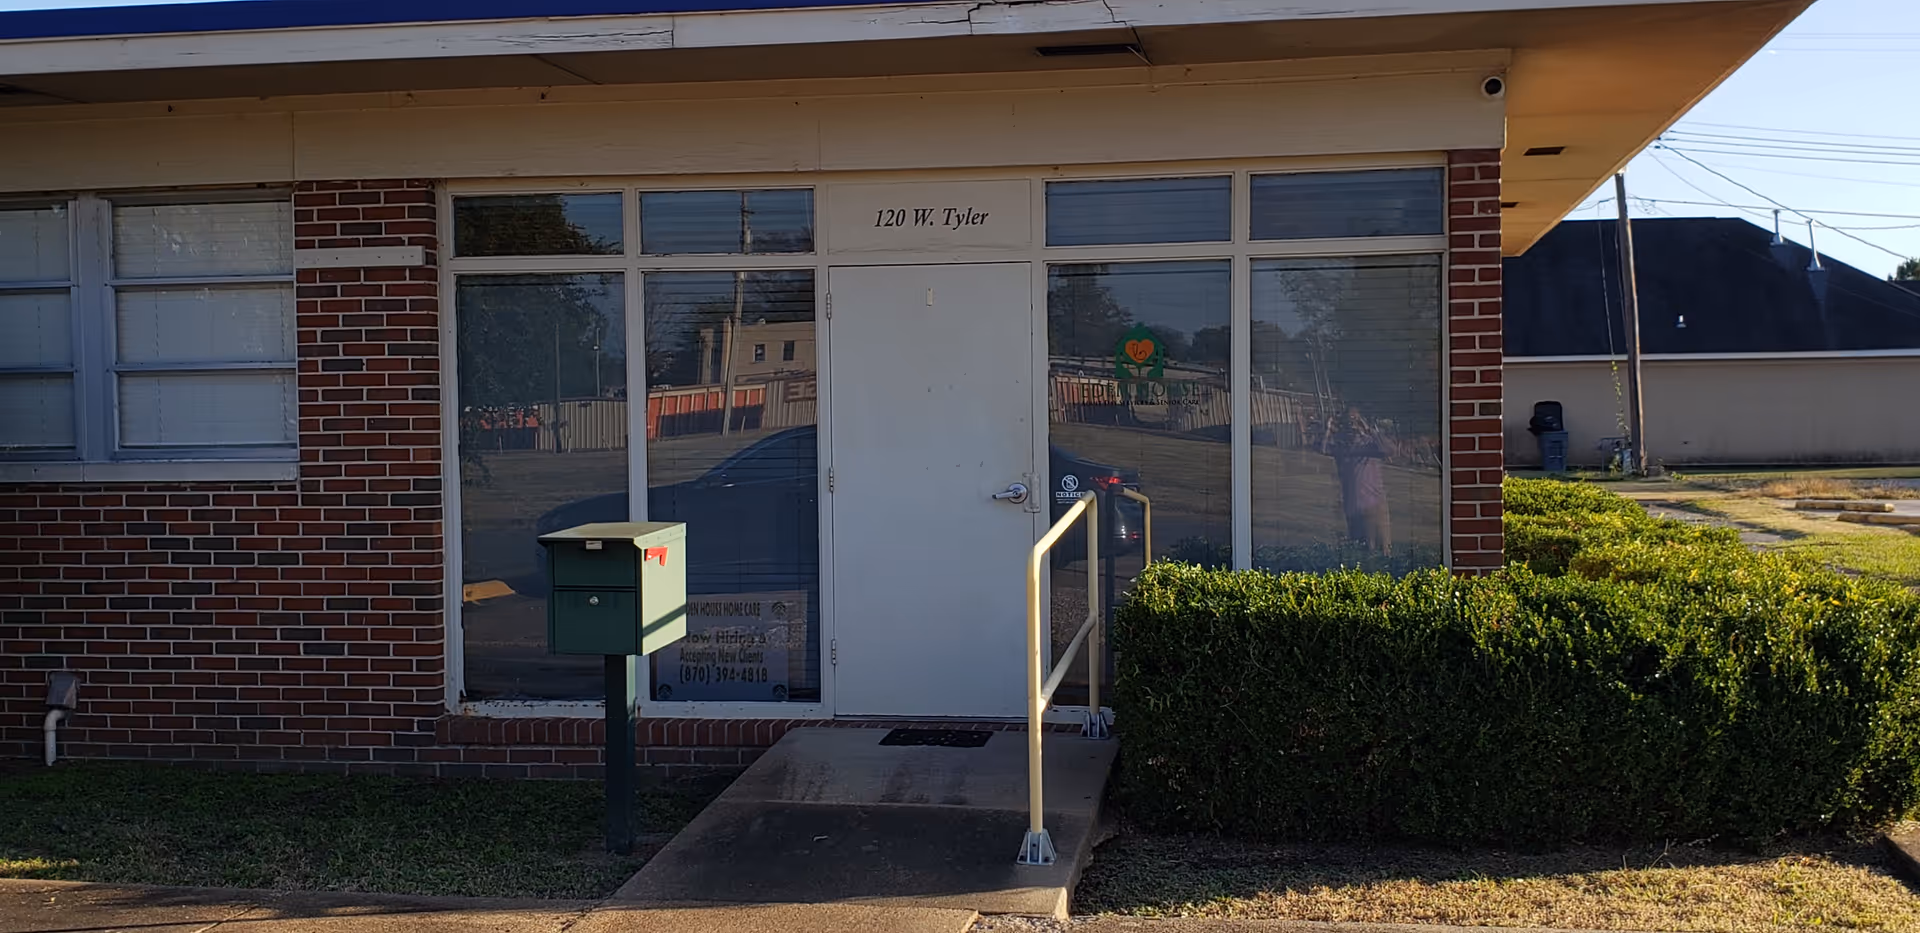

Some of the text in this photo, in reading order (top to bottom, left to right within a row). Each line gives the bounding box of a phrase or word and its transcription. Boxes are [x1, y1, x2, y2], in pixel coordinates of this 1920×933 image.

[874, 206, 989, 231] 120 W. Tyler
[687, 602, 761, 617] DEN HOUSE HOME CARE
[680, 648, 764, 668] Accepting New Clients
[680, 664, 768, 685] (870) 394-4818
